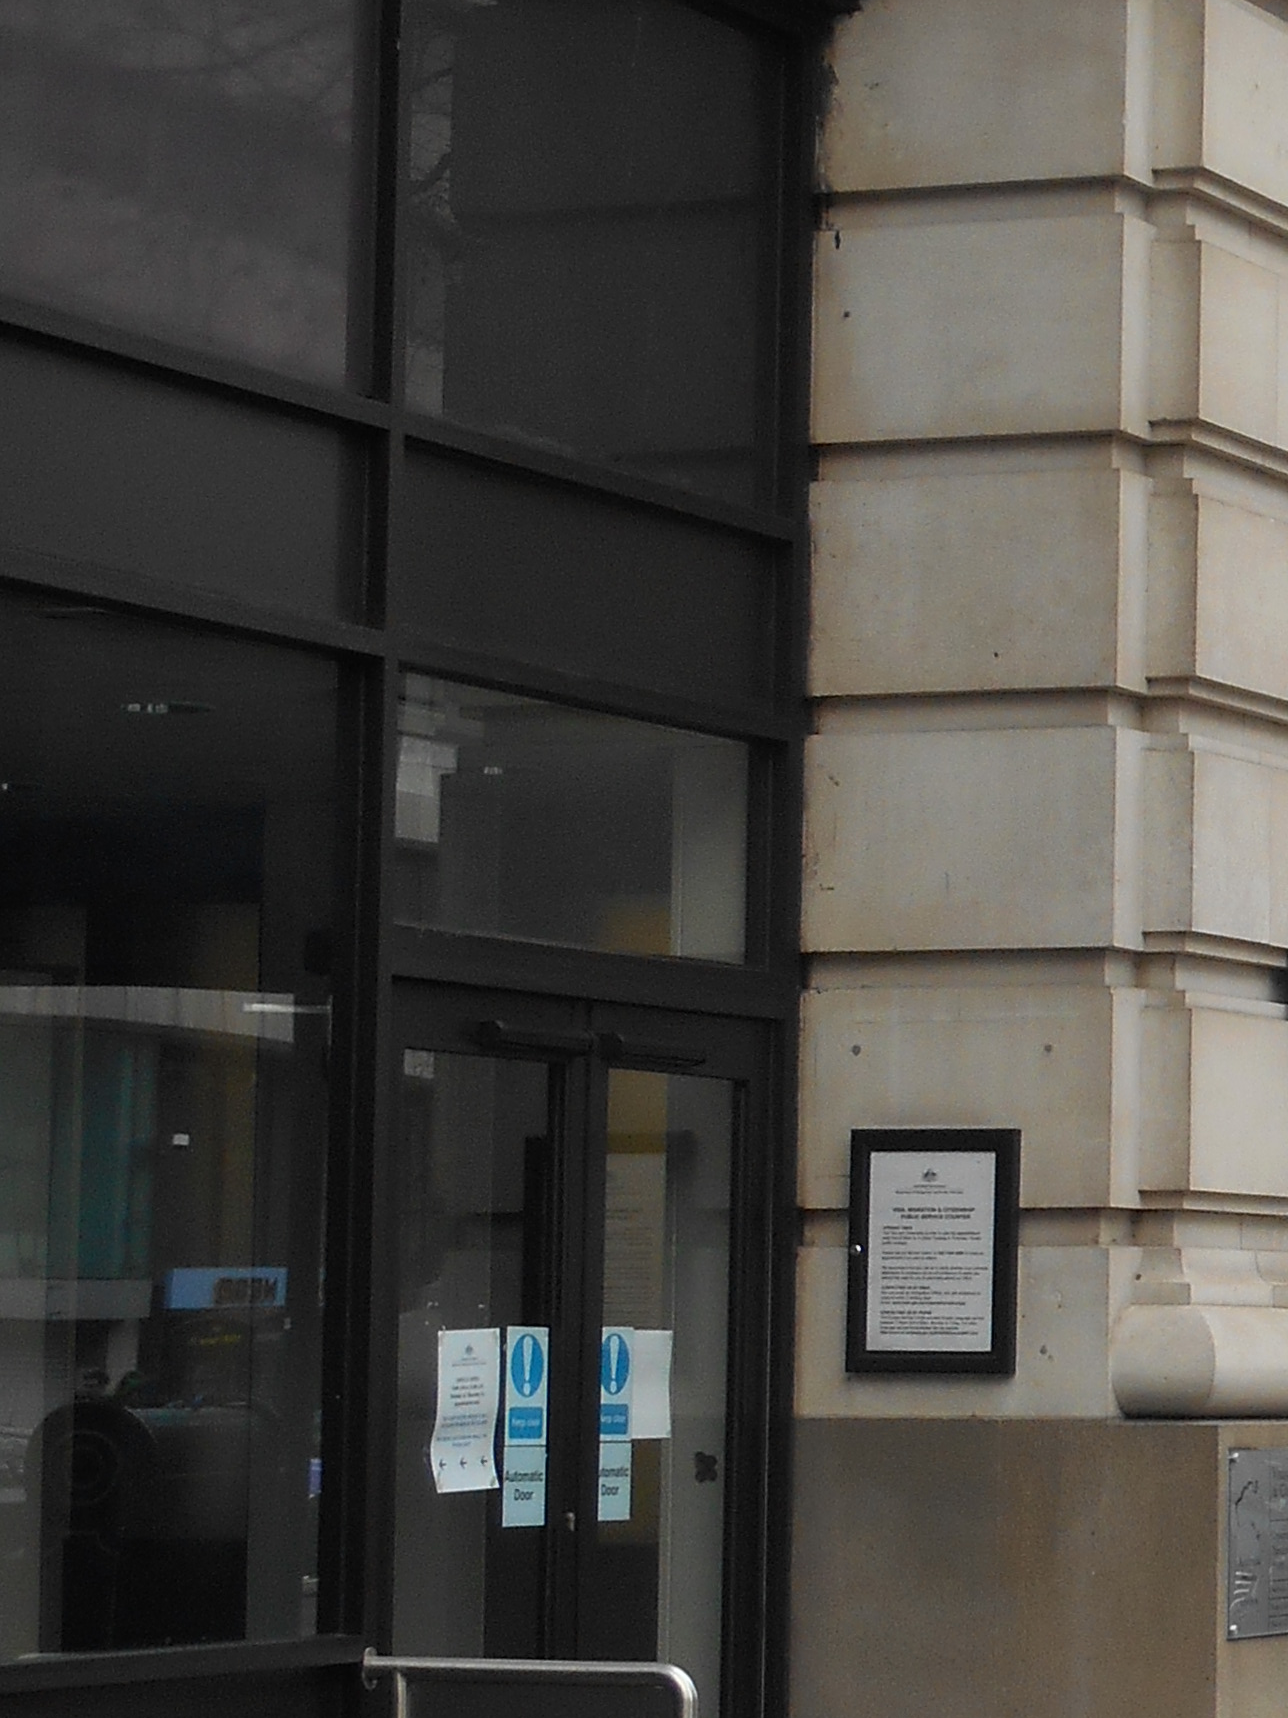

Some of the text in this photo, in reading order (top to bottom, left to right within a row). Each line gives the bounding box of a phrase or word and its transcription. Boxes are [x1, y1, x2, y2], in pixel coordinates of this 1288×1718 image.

[506, 1470, 543, 1482] Automatic
[514, 1488, 534, 1501] Door
[601, 1484, 619, 1496] Door
